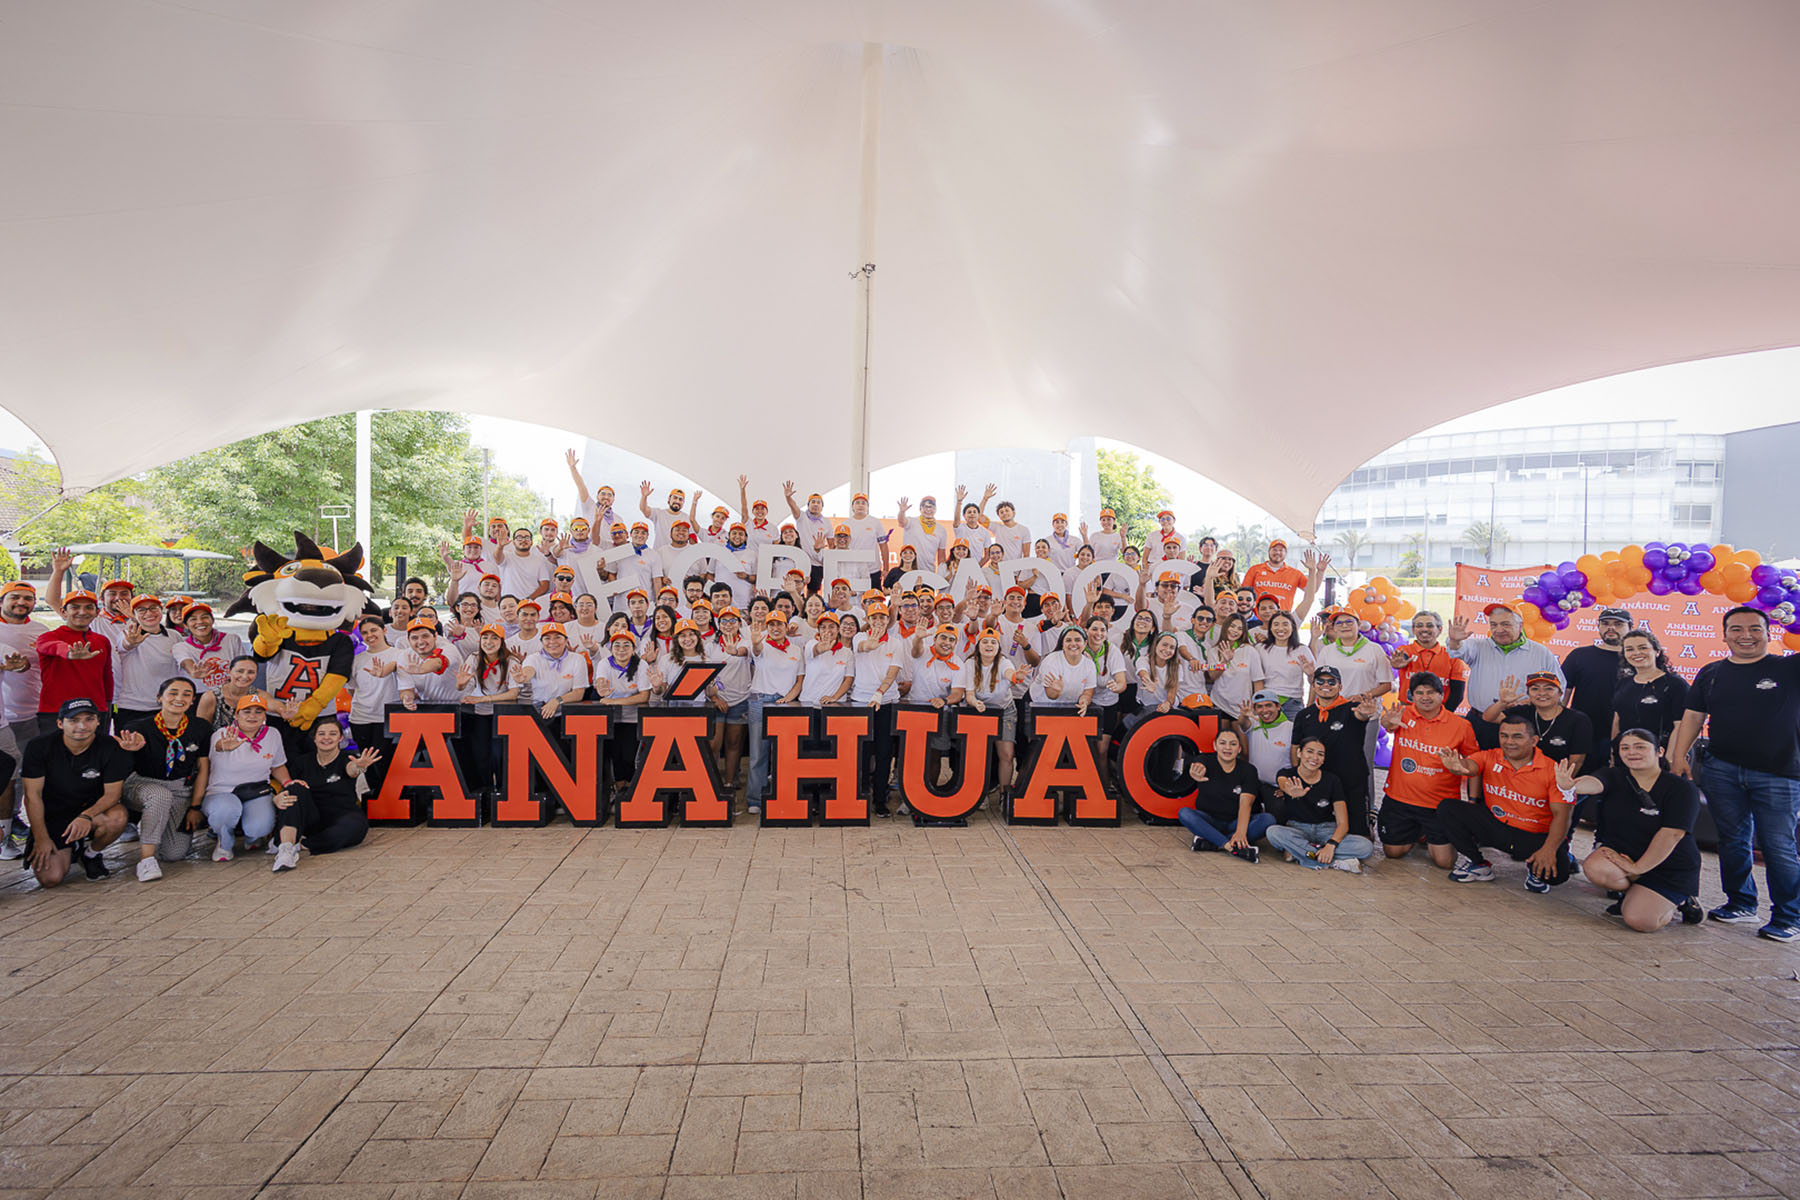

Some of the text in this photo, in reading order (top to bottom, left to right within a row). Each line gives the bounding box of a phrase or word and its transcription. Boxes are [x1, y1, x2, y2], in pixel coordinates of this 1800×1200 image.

[1620, 600, 1671, 611] ANÁHUAC
[1682, 602, 1700, 615] A
[1666, 622, 1714, 631] ANÁHUAC
[1664, 630, 1715, 638] VERACRUZ
[1679, 645, 1697, 658] A
[275, 655, 321, 701] A
[366, 664, 1220, 826] ANÁHUAC
